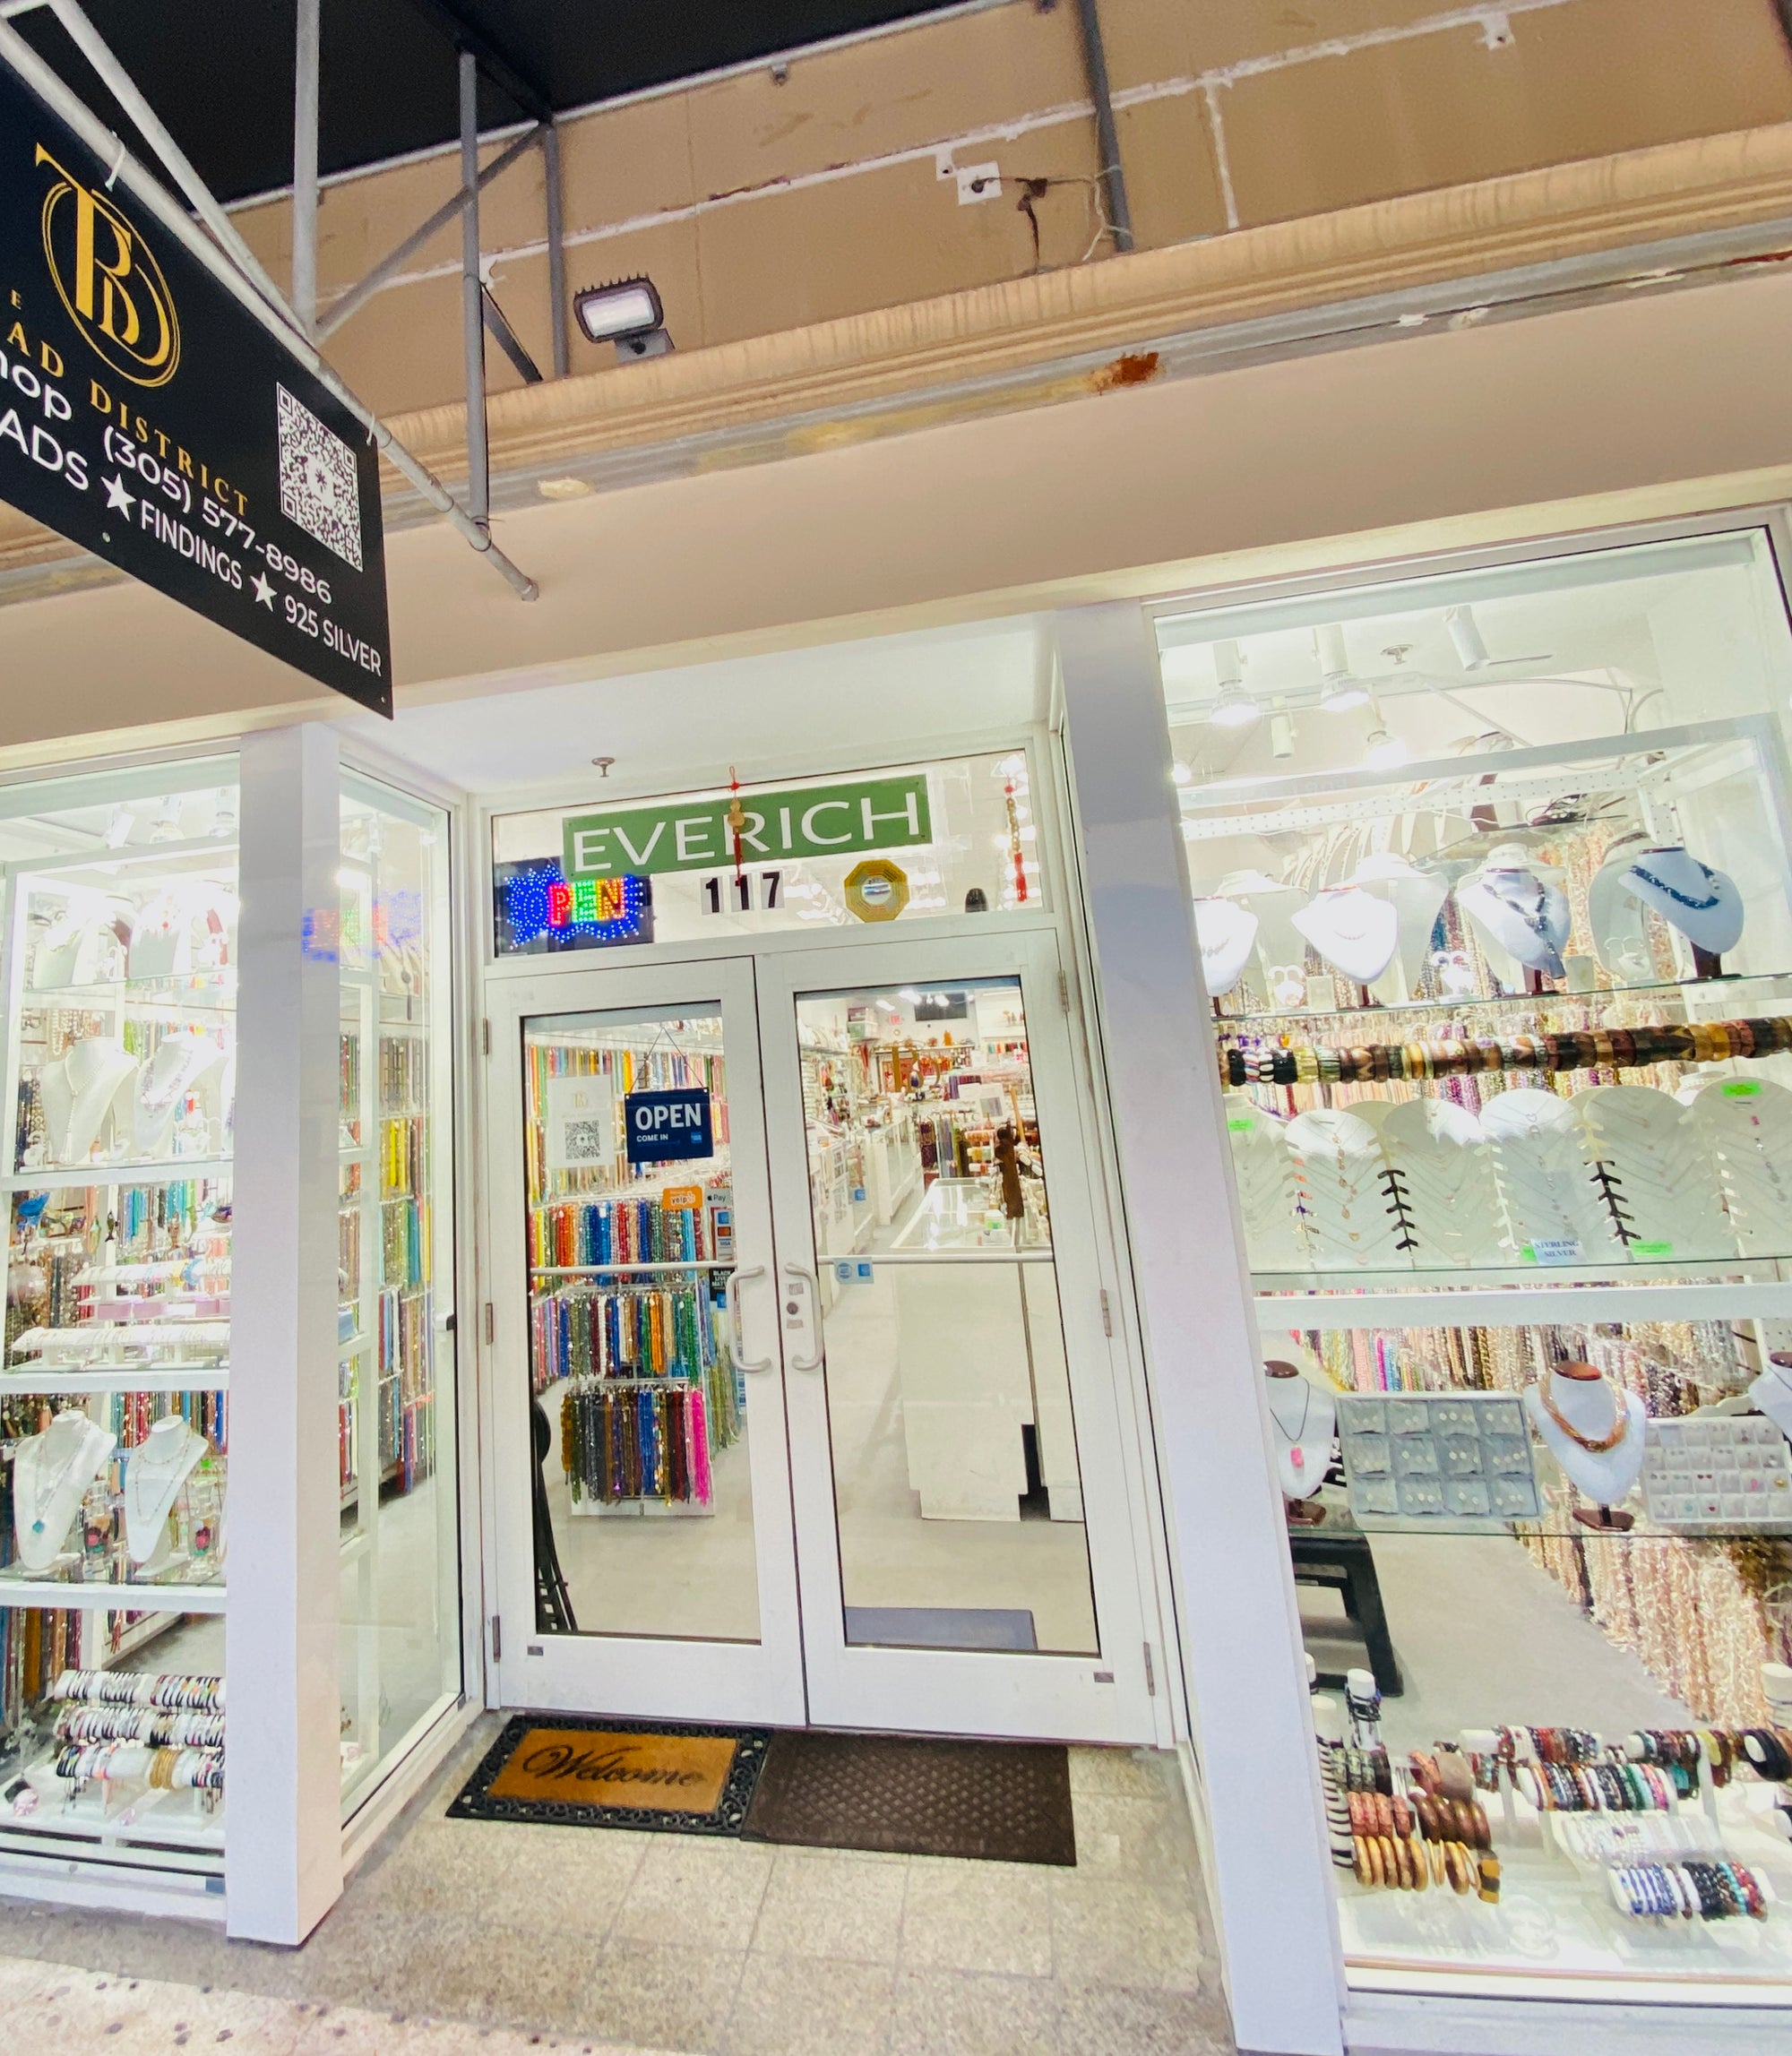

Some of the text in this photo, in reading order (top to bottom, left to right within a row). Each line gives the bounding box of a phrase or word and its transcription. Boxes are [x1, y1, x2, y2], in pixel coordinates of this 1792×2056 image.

[90, 378, 248, 516] DISTRICT
[103, 425, 193, 513] (305)
[202, 495, 332, 605] 577-8986
[141, 499, 243, 589] FINDINGS
[284, 594, 319, 638] 925
[323, 619, 382, 676] SILVER
[573, 791, 920, 873] EVERICH
[522, 875, 626, 927] OPEN
[705, 871, 780, 914] 117
[635, 1103, 702, 1131] OPEN
[636, 1133, 659, 1142] COME
[670, 1196, 688, 1205] yelp
[713, 1193, 727, 1203] Pay
[1533, 1240, 1580, 1249] STERLING
[1543, 1249, 1577, 1257] SILVER
[522, 1744, 708, 1786] Welcome
